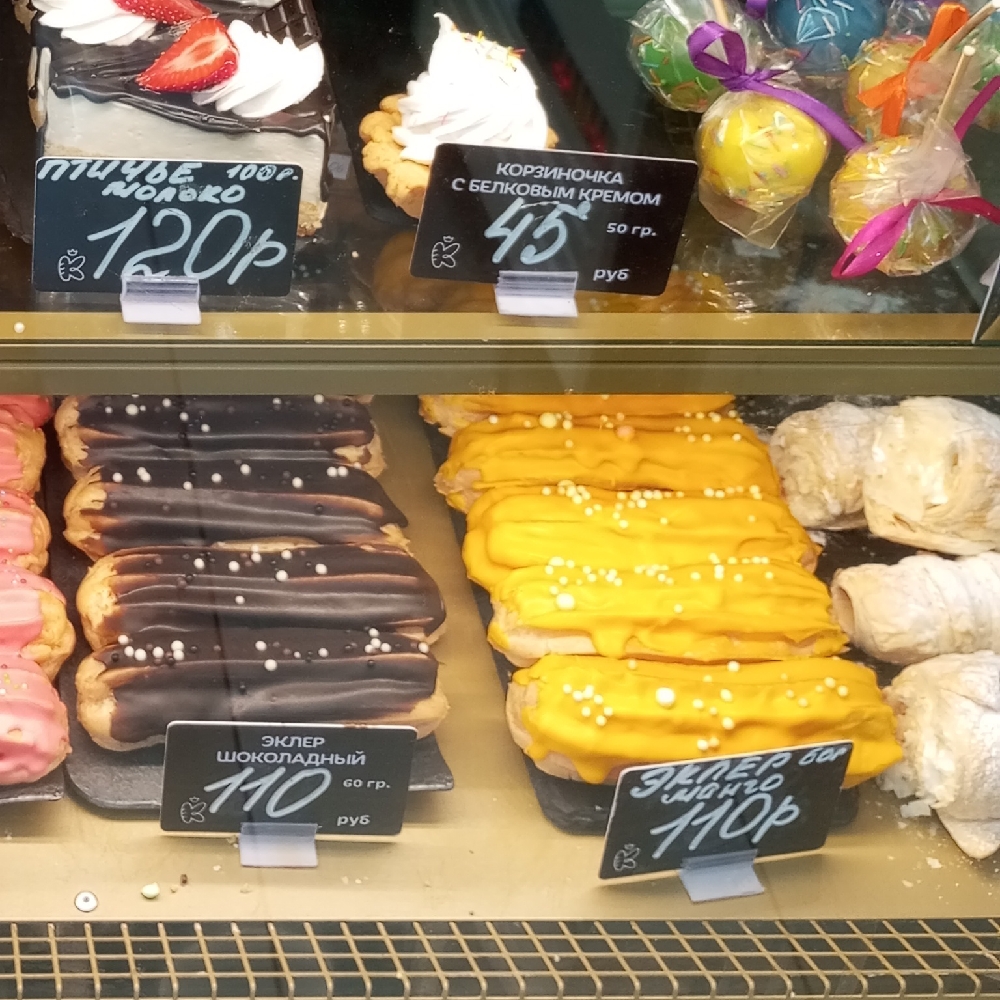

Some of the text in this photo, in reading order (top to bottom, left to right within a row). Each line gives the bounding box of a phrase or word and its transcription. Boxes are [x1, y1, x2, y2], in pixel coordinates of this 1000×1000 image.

[496, 162, 624, 185] КОРЗИНОЧКА
[451, 177, 662, 207] С БЕЛКОВЫМ КРЕМОМ
[484, 197, 591, 265] 45
[607, 222, 657, 238] 50 гр.
[593, 267, 630, 282] руб
[261, 736, 326, 748] ЭКЛЕР
[216, 751, 366, 767] ШОКОЛАДНЫЙ
[203, 766, 332, 818] 110
[343, 778, 391, 790] 60 гр.
[336, 815, 371, 828] руб
